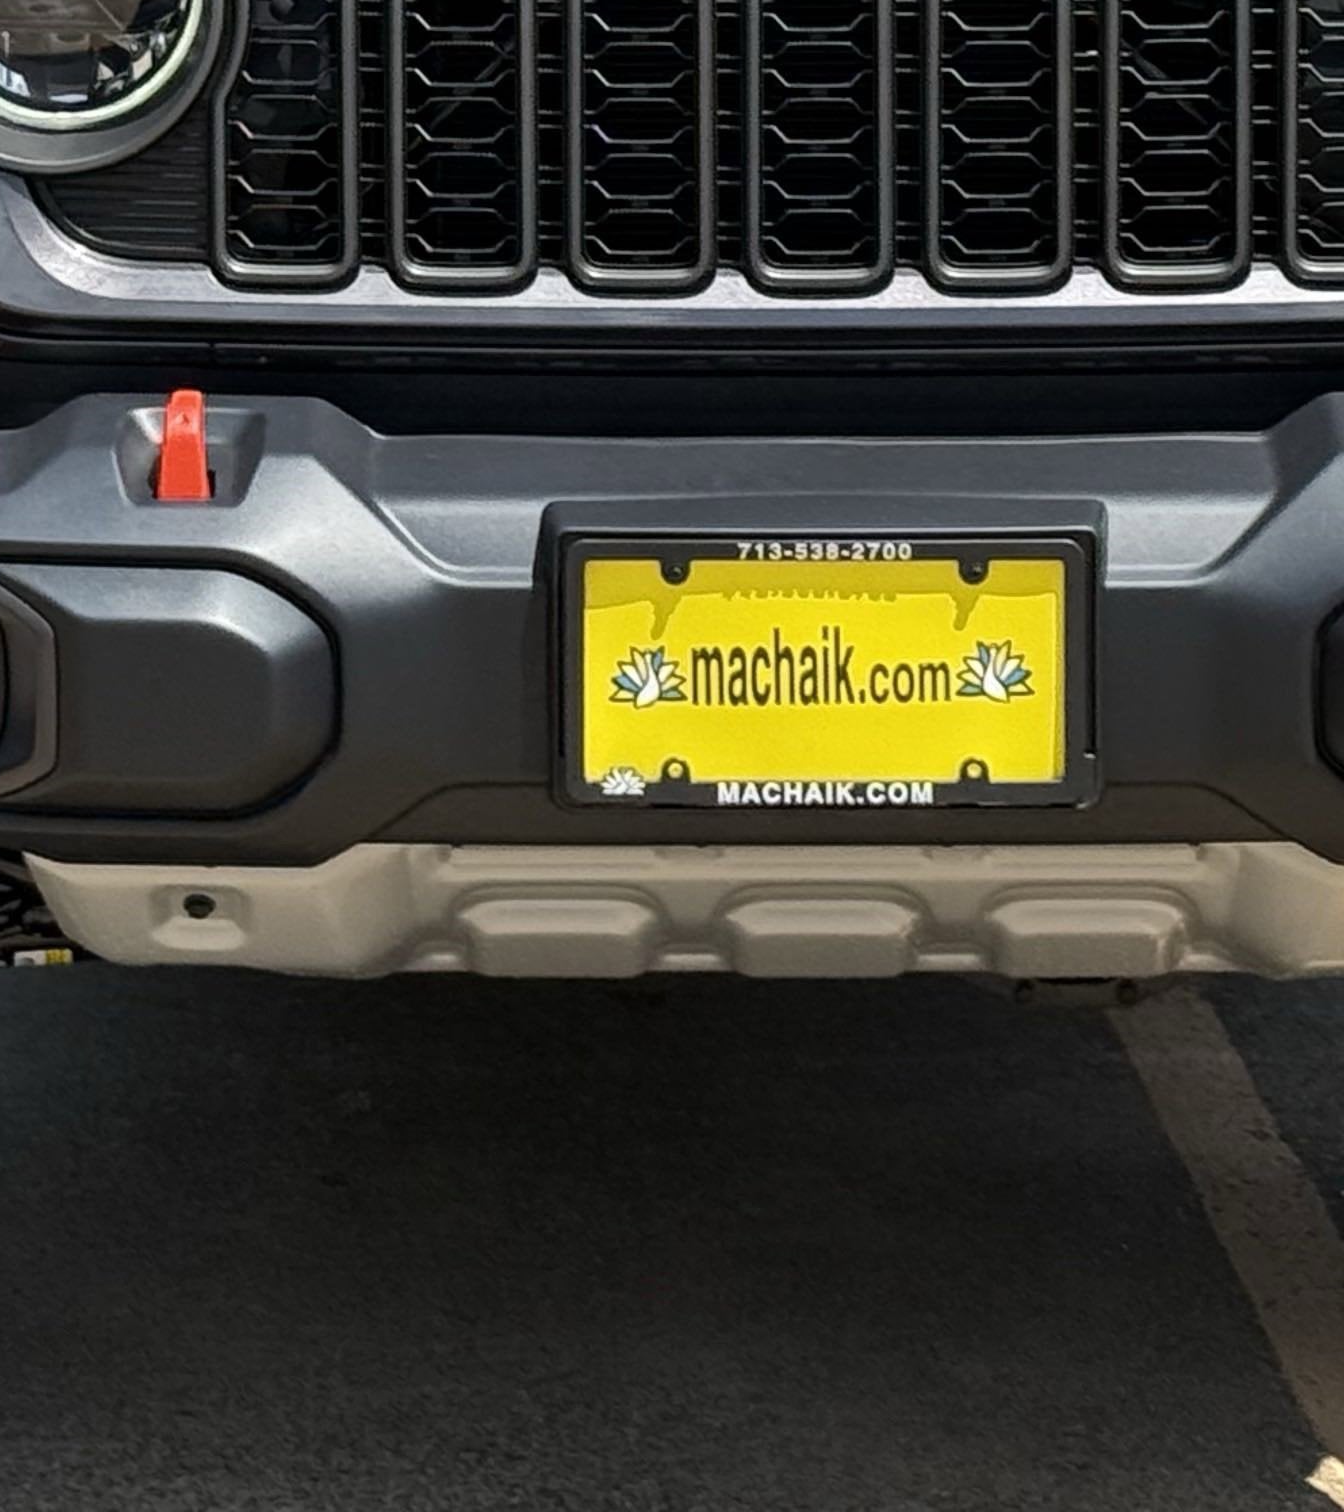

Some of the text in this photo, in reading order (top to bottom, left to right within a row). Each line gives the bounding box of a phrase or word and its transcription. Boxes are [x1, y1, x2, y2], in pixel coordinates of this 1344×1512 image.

[737, 541, 913, 561] 713-538-2700
[691, 625, 952, 706] machaik.com
[716, 780, 935, 805] MACHAIK.COM
